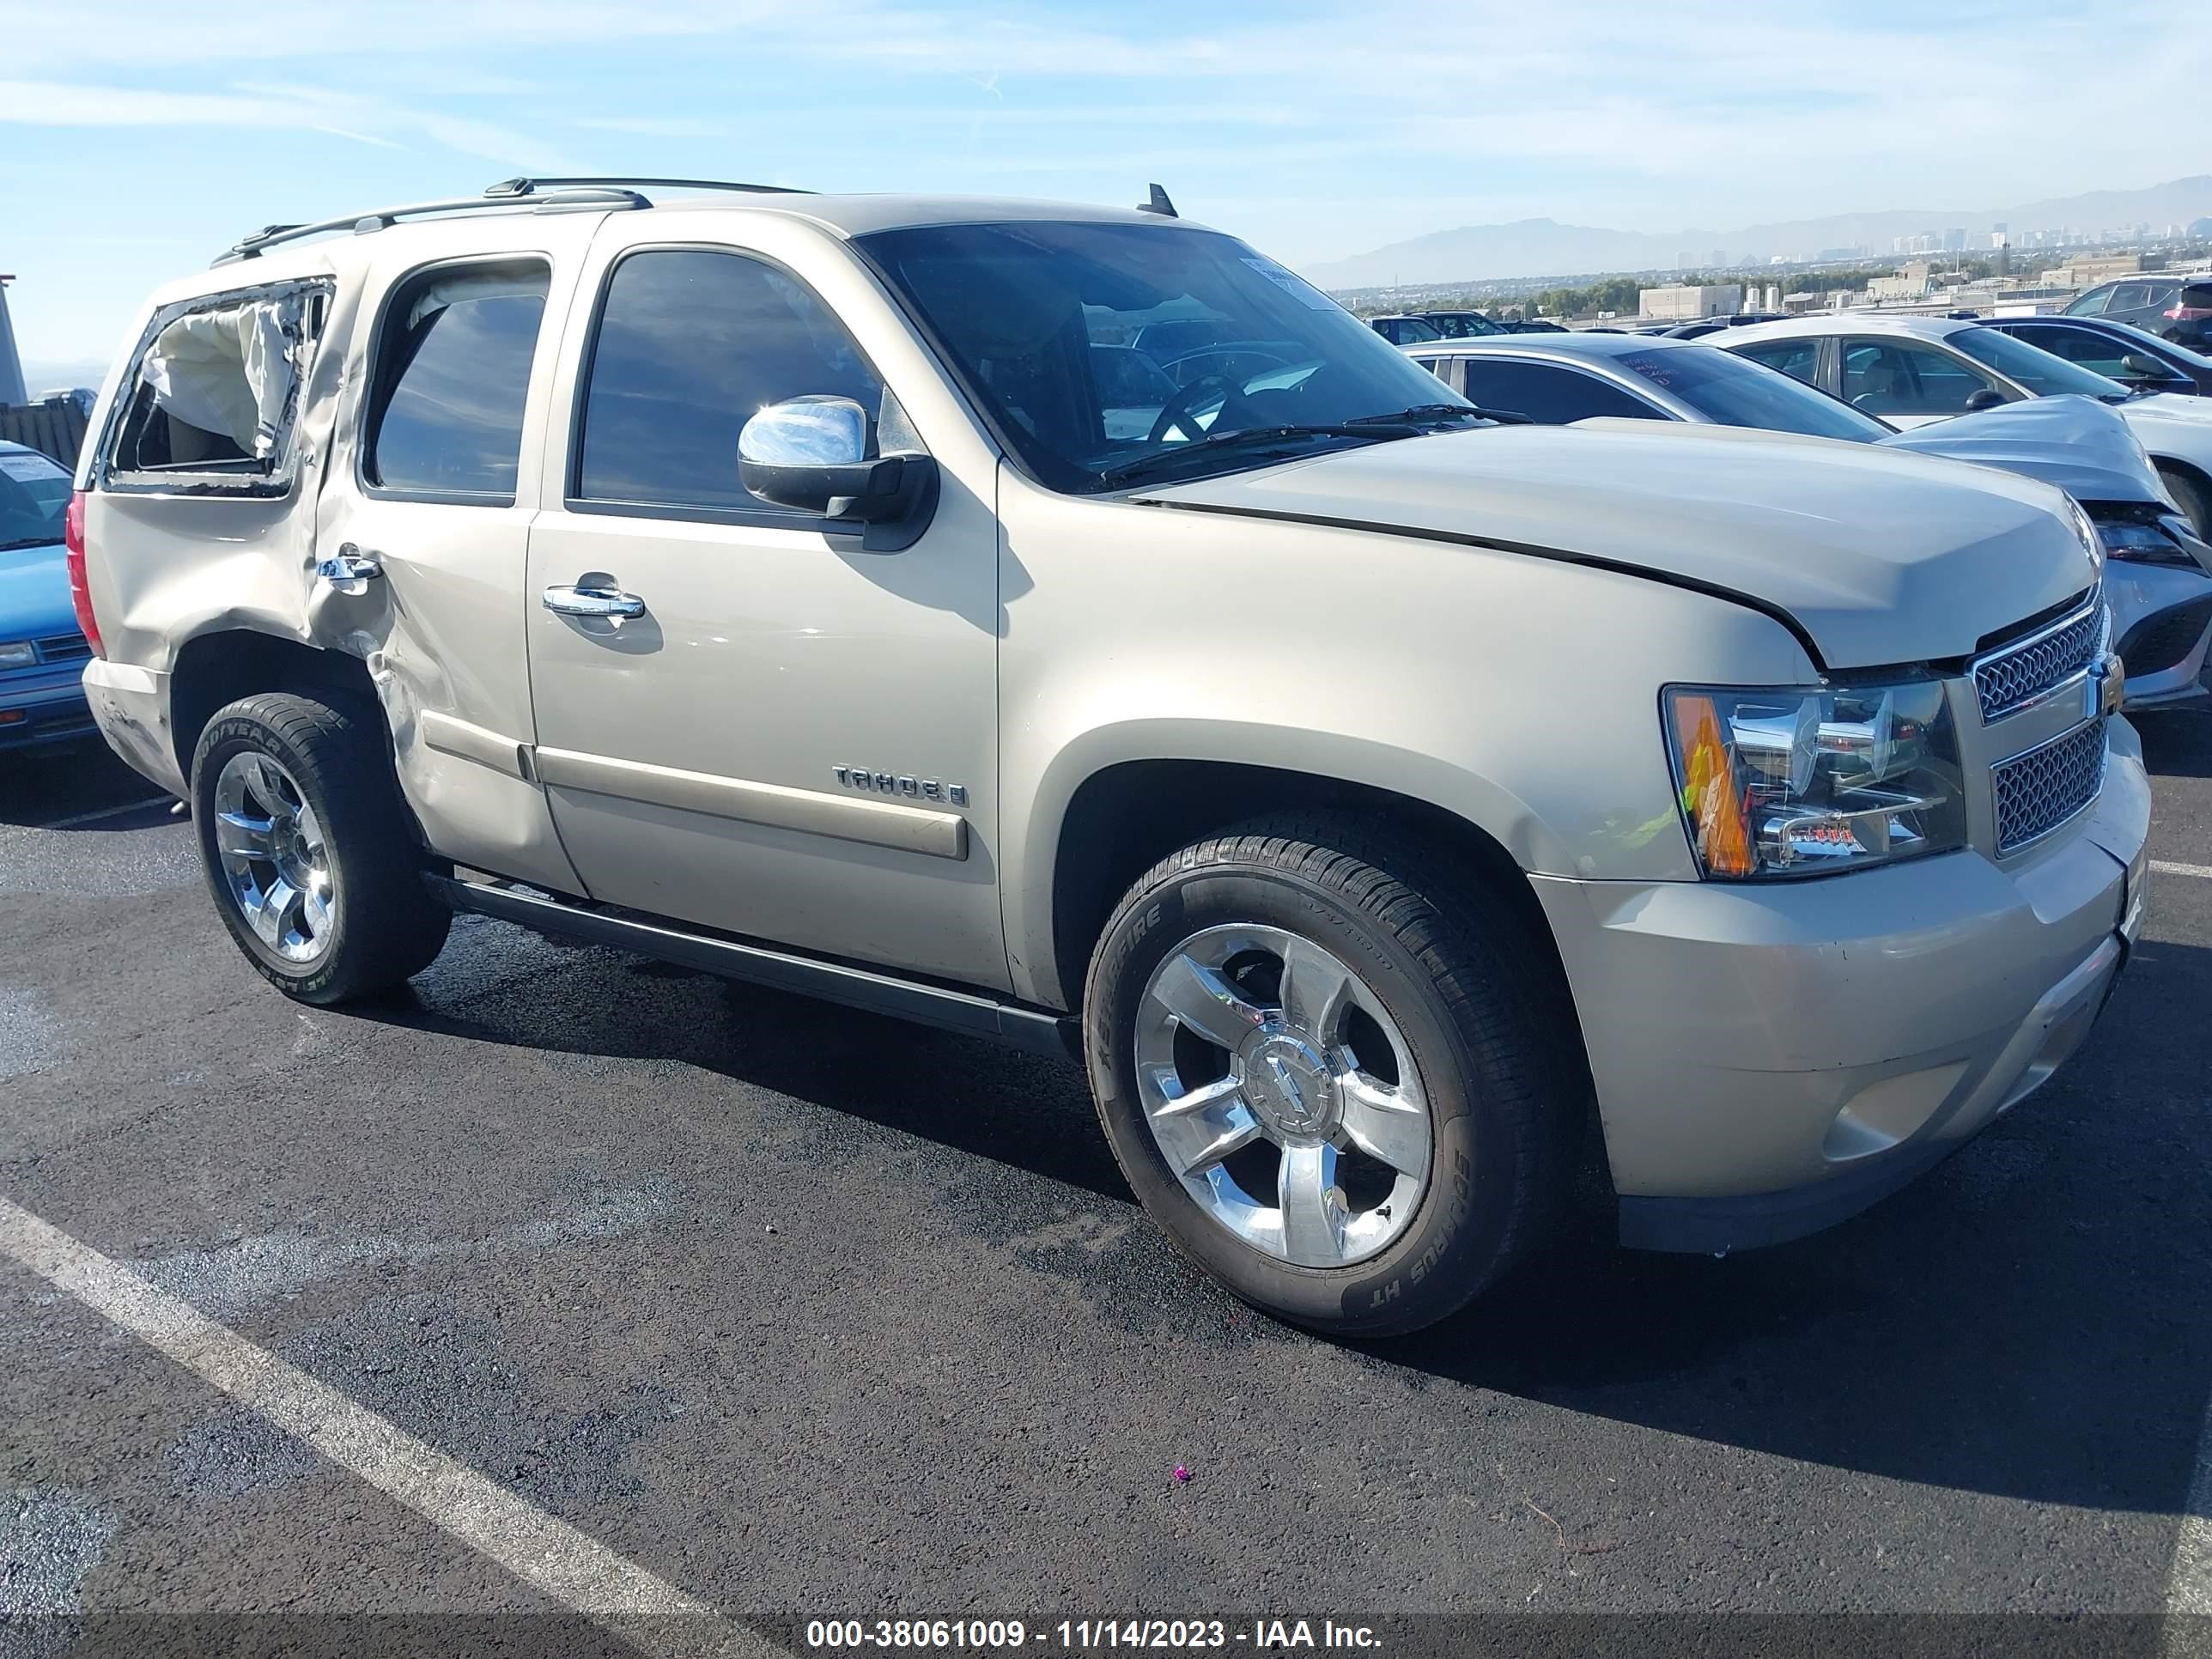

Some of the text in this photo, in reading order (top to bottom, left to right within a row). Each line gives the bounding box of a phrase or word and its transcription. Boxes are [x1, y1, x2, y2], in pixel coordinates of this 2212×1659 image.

[831, 765, 941, 799] TAHOE
[1097, 902, 1162, 1047] SRFIRE
[1367, 1279, 1402, 1310] HT
